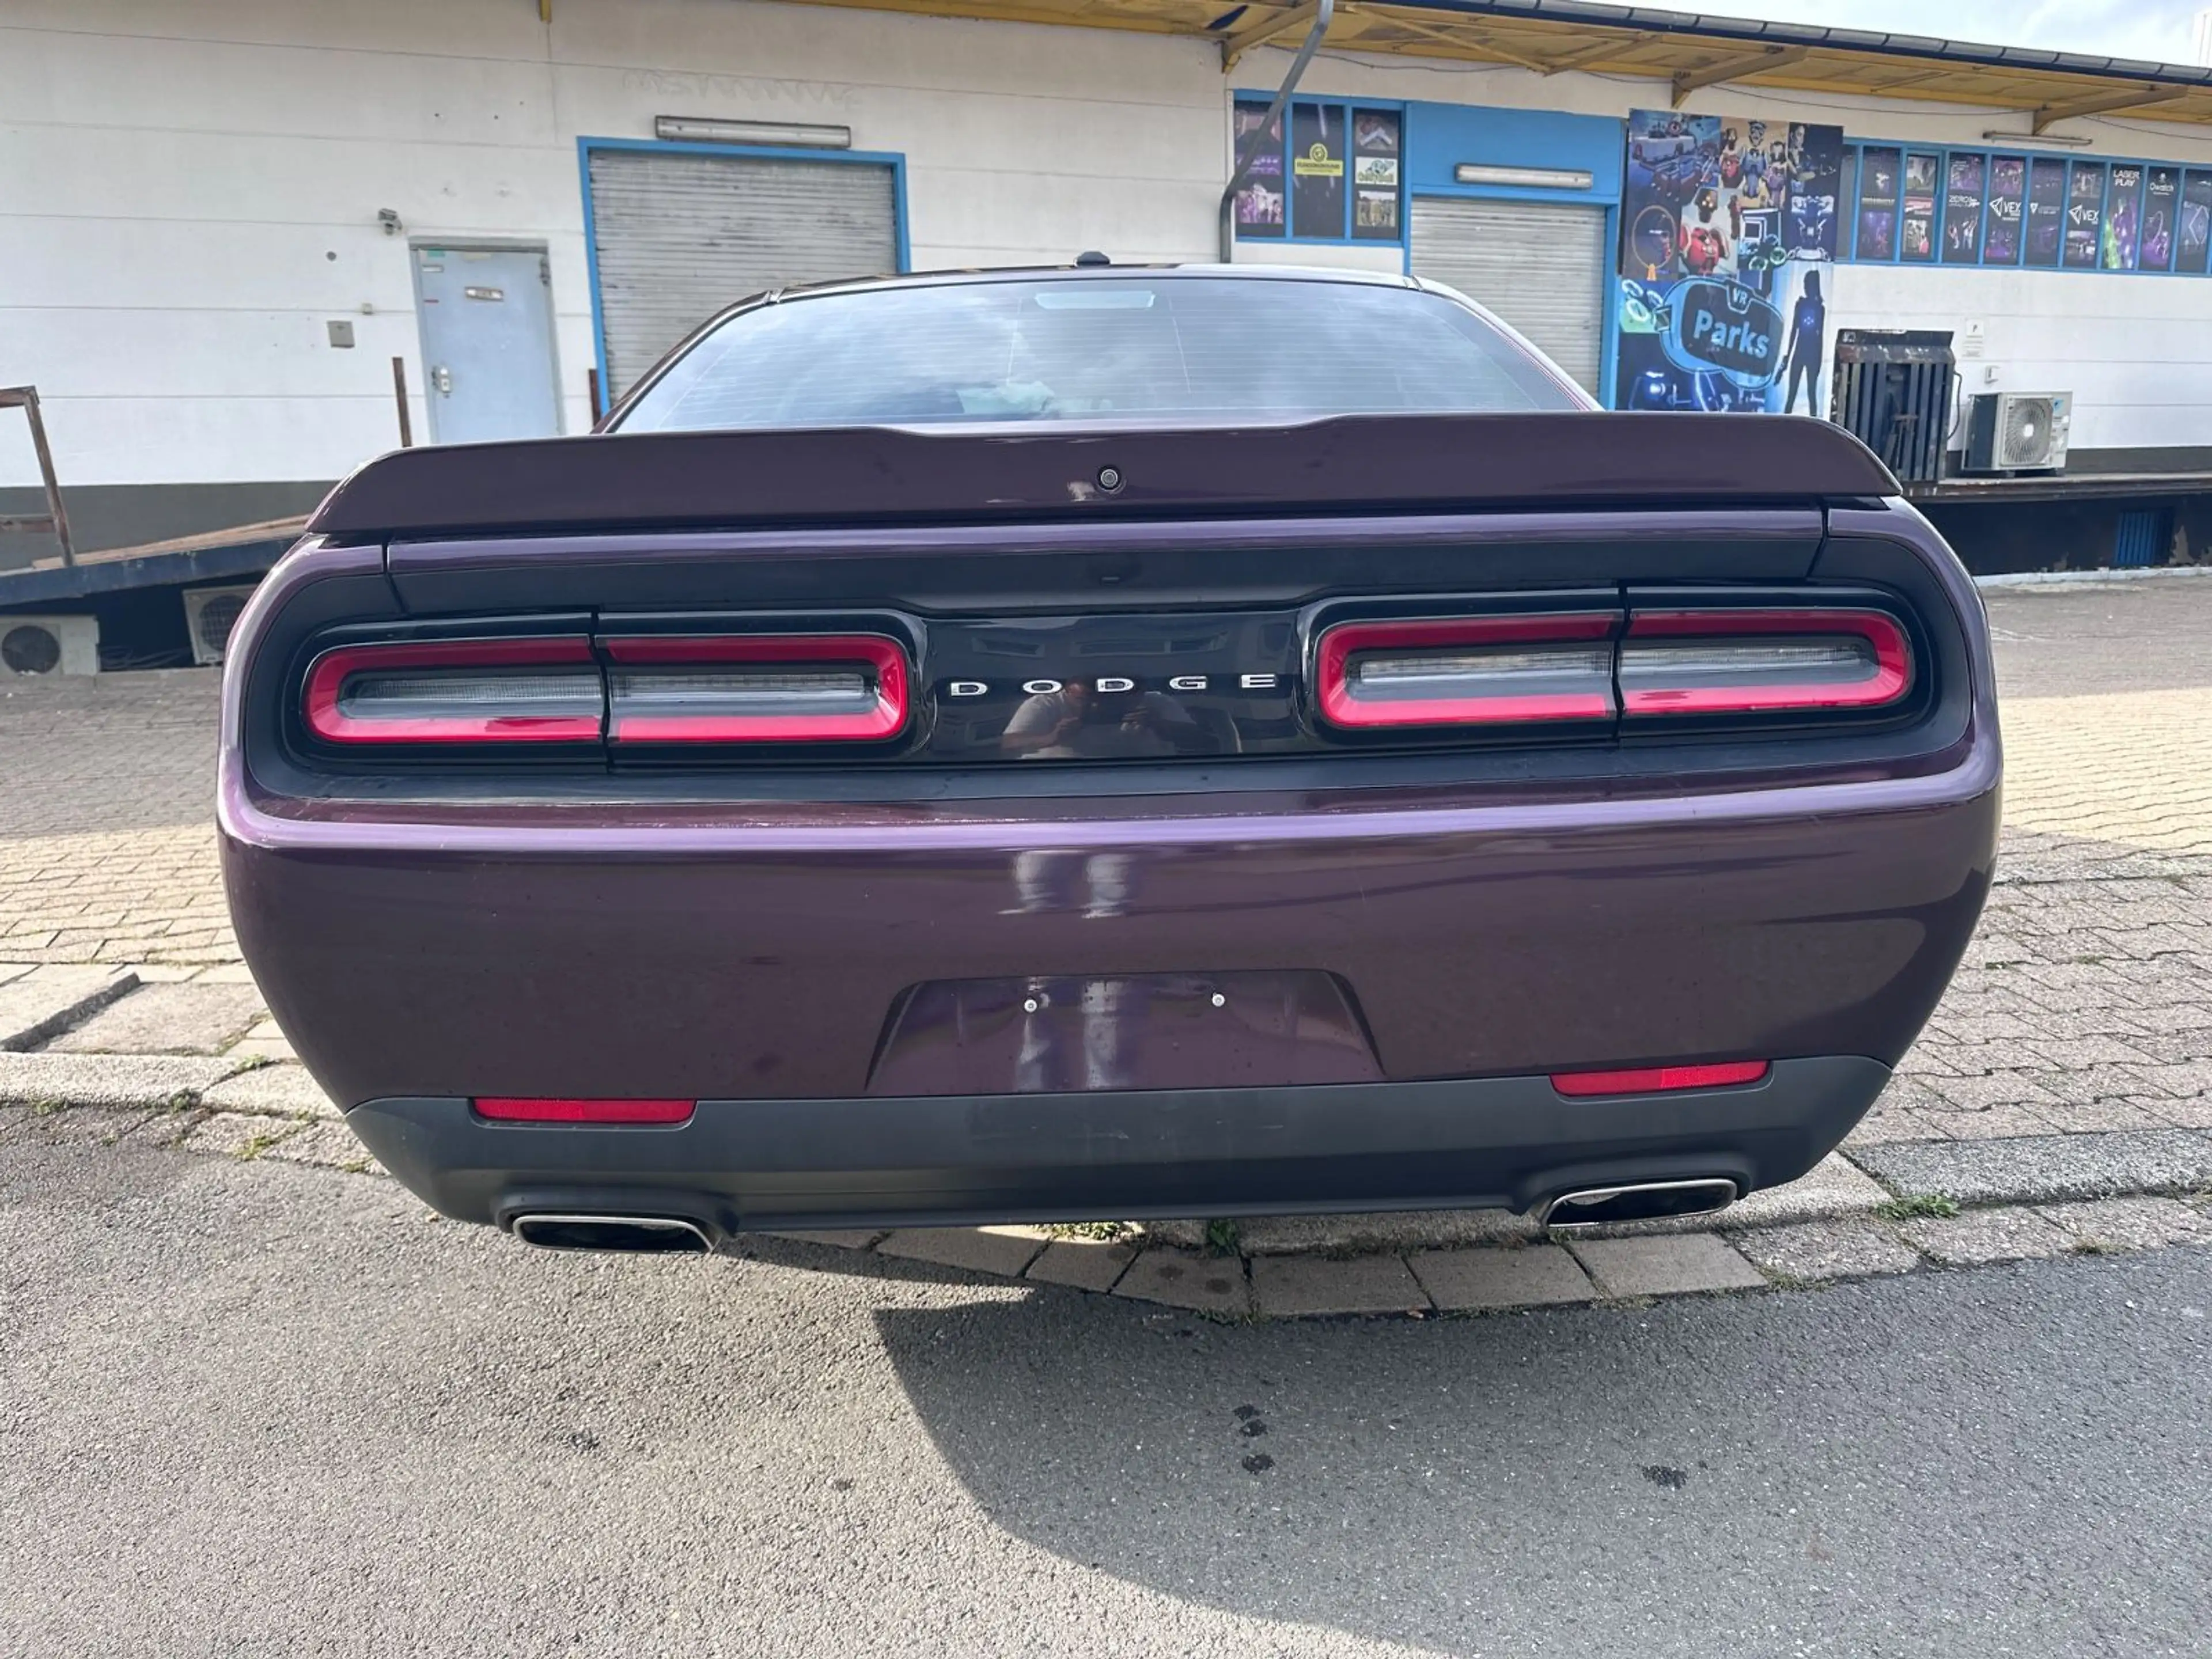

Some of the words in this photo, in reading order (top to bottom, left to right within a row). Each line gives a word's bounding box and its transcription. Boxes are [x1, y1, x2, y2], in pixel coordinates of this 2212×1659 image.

[2113, 170, 2139, 180] LASER
[2115, 178, 2135, 187] PLAY
[2003, 201, 2021, 213] VEX
[1733, 287, 1748, 305] VR
[1694, 309, 1770, 358] Parks
[950, 674, 1276, 696] DODGE
